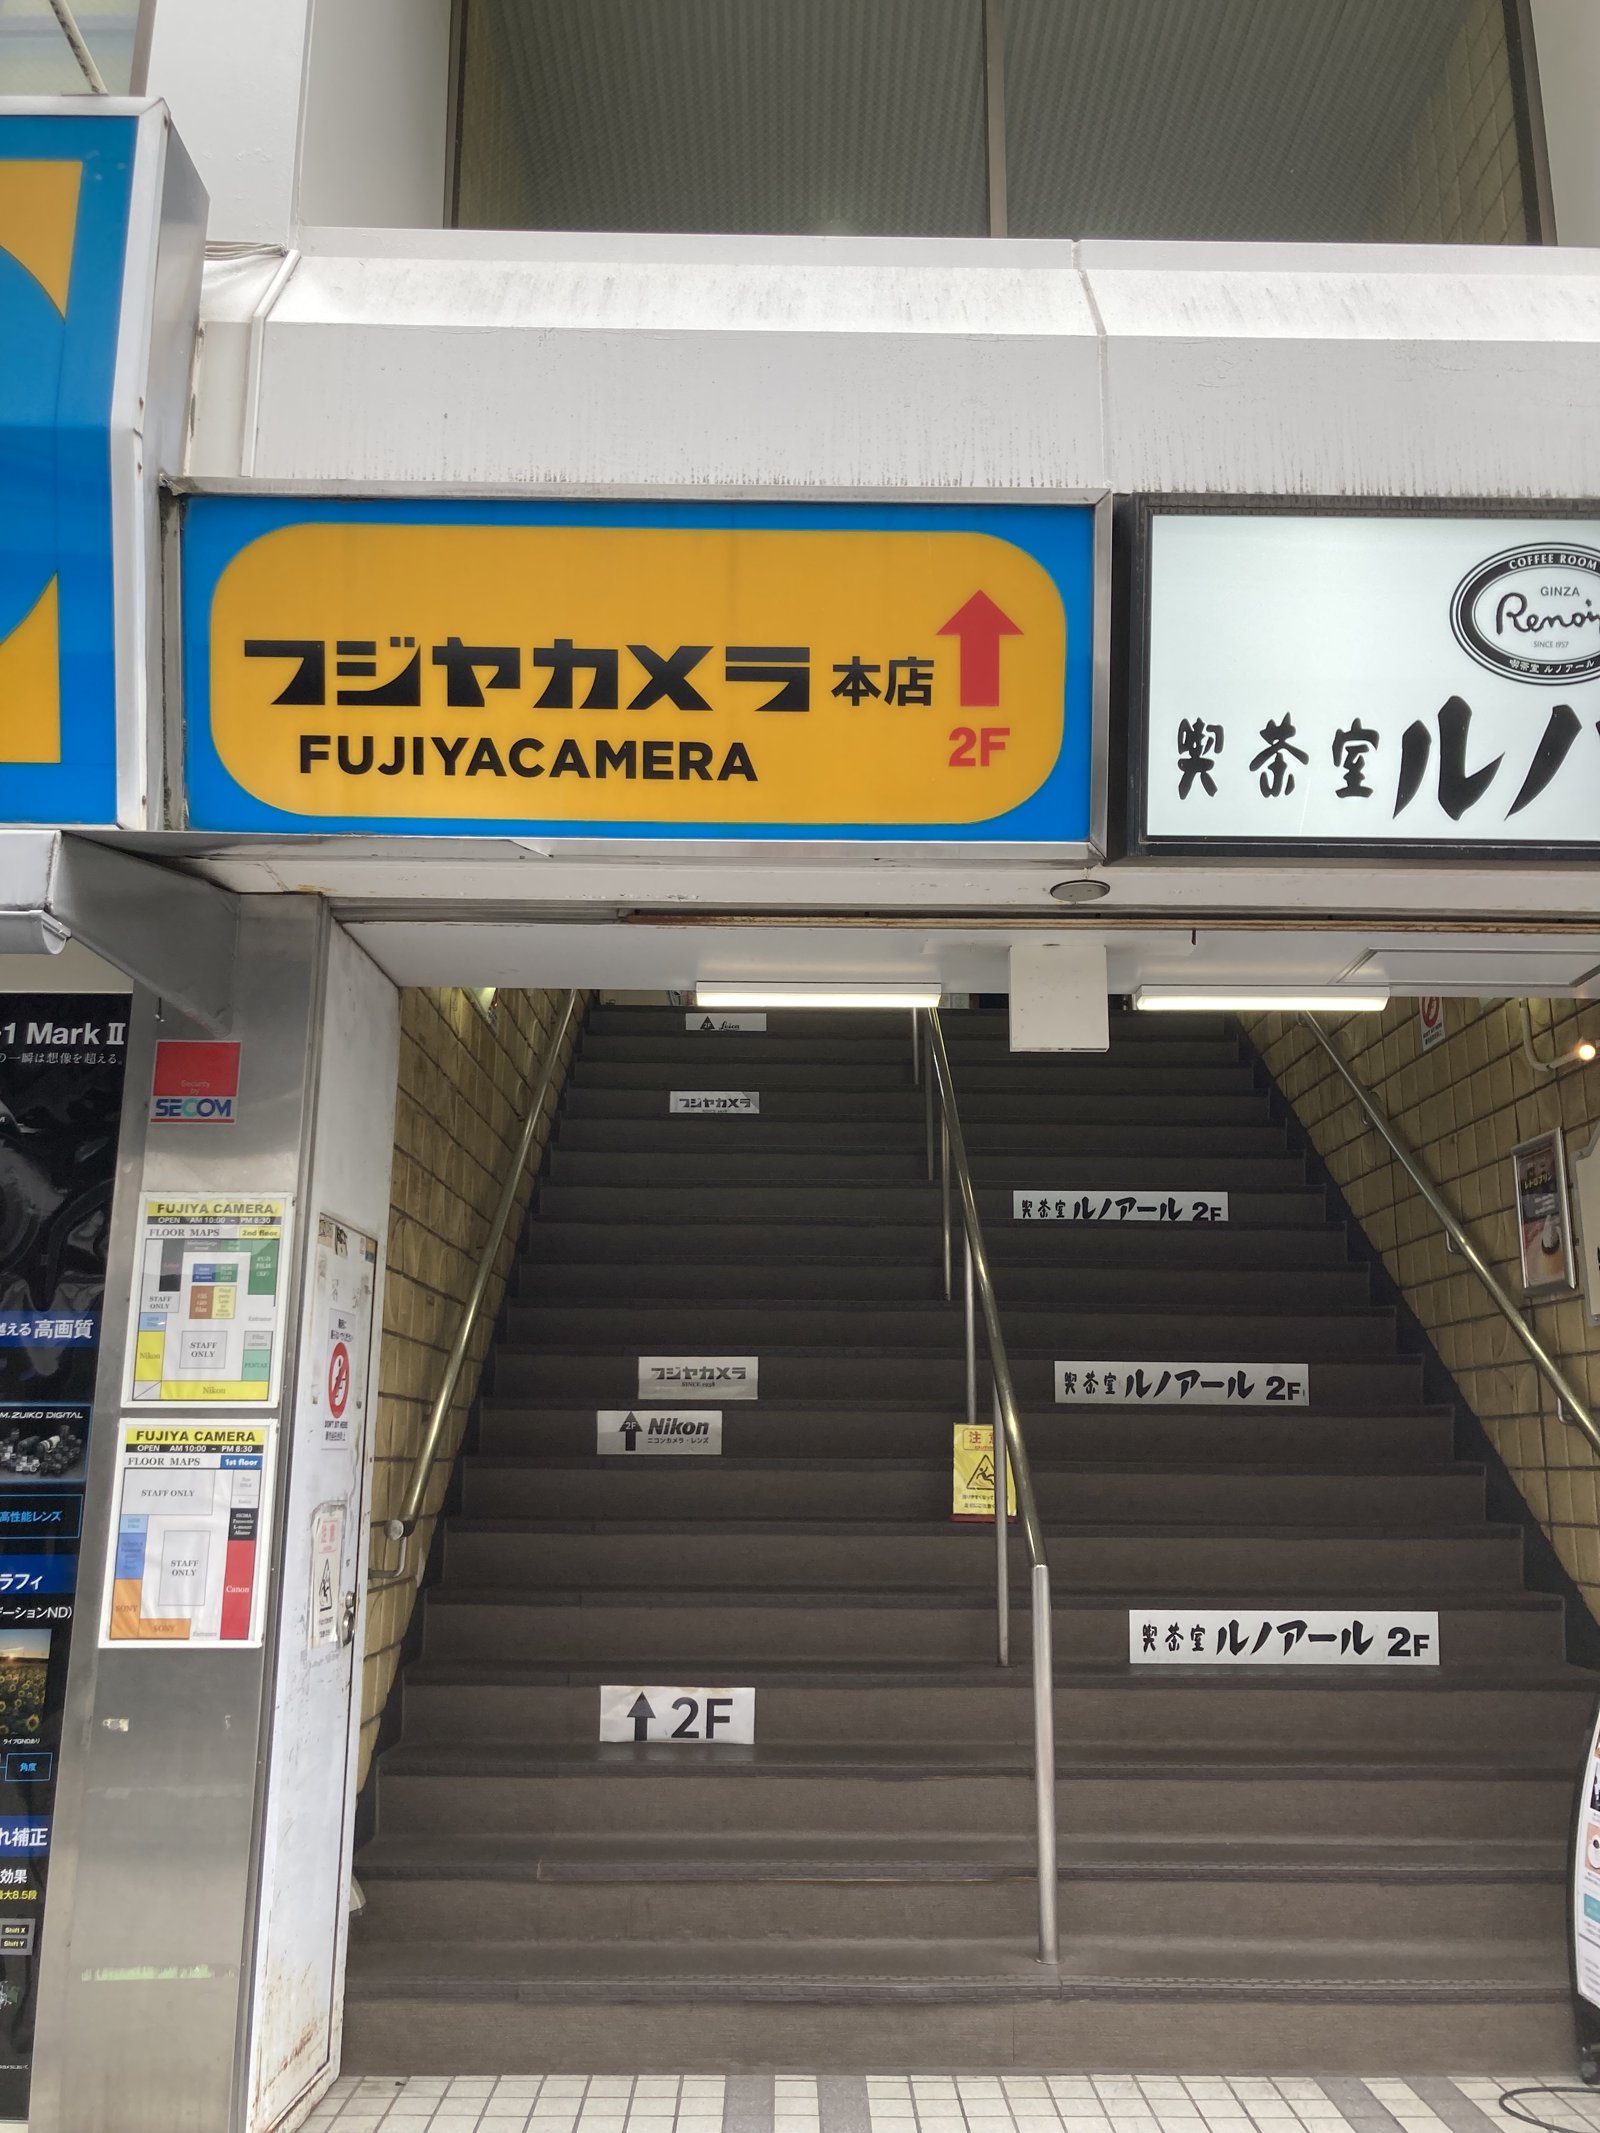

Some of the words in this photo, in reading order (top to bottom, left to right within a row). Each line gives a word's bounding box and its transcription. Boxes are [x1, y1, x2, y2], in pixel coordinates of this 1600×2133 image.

[1509, 554, 1554, 570] COFFEE
[1560, 554, 1597, 570] ROOM
[1540, 586, 1580, 597] GINZA
[1496, 592, 1600, 635] Renoi
[244, 636, 810, 711] フジヤカメラ
[831, 655, 934, 707] 本店
[949, 727, 1010, 767] 2F
[300, 734, 758, 782] FUJIYACAMERA
[1177, 695, 1600, 821] 喫茶室ルノ
[719, 1021, 740, 1030] Leica
[0, 1022, 16, 1044] 1
[26, 1022, 101, 1045] Mark
[156, 1098, 232, 1117] SECOM
[679, 1097, 751, 1108] フジヤカメラ
[157, 1203, 209, 1214] FUJIYA
[213, 1204, 274, 1214] CAMERA
[1192, 1202, 1222, 1221] 2F
[149, 1229, 185, 1237] FLOOR
[189, 1229, 220, 1237] MAPS
[139, 1352, 161, 1360] Nikon
[651, 1366, 746, 1380] フジヤカメラ
[1266, 1376, 1301, 1400] 2F
[46, 1411, 84, 1419] DIGITAL
[625, 1422, 636, 1430] 2F
[648, 1417, 709, 1435] Nikon
[136, 1431, 189, 1441] FUJIYA
[194, 1431, 256, 1442] CAMERA
[969, 1431, 993, 1444] 注
[128, 1457, 165, 1466] FLOOR
[169, 1457, 200, 1466] MAPS
[141, 1489, 170, 1497] STAFF
[170, 1489, 195, 1497] ONLY
[0, 1606, 73, 1619] ーションND)
[1387, 1627, 1430, 1657] 2F
[670, 1696, 733, 1739] 2F
[0, 1868, 27, 1884] 効果
